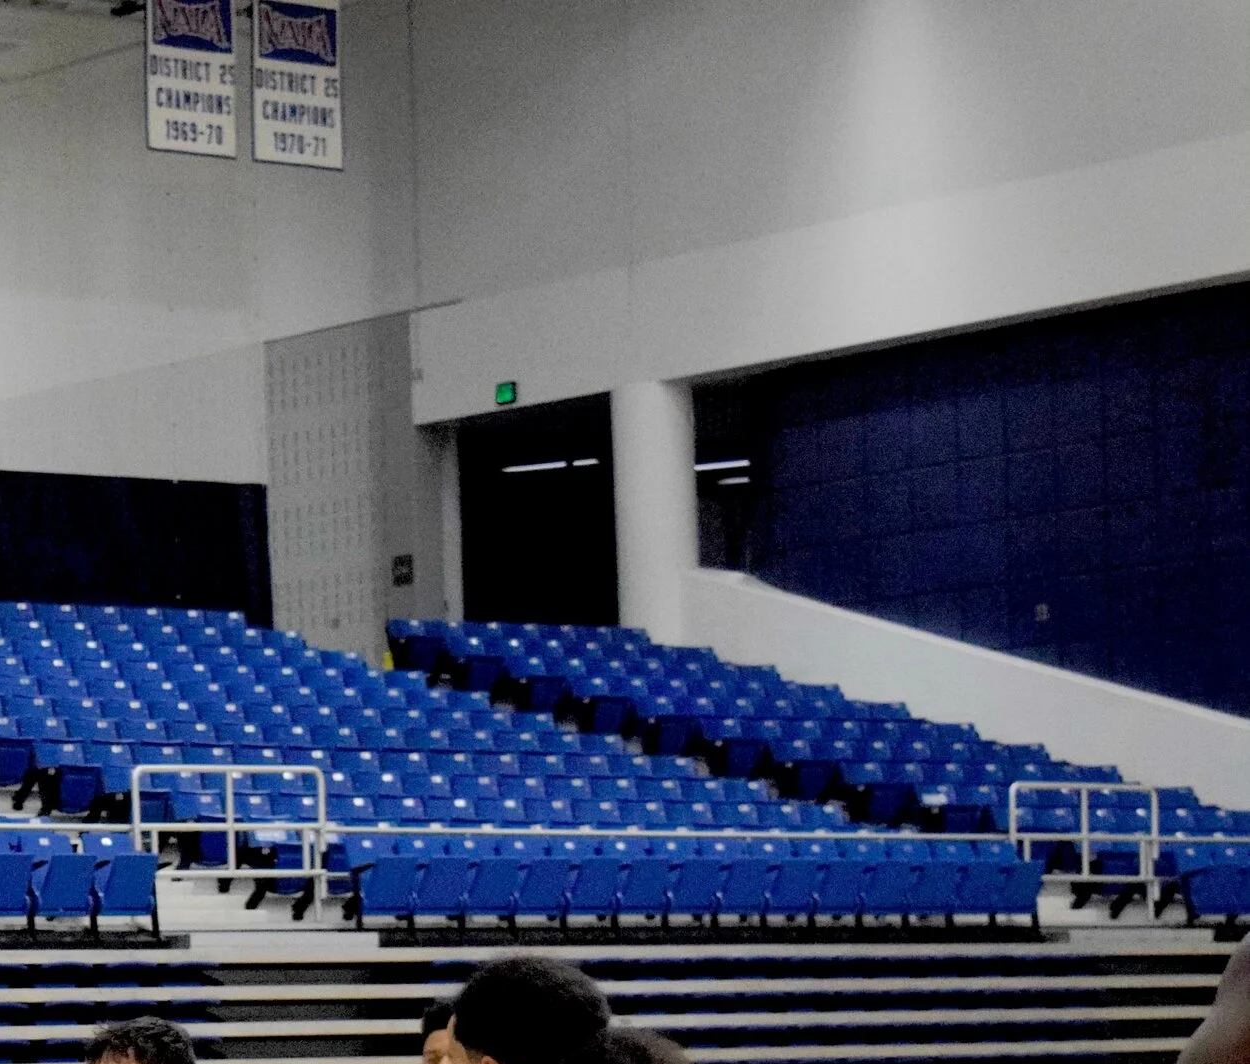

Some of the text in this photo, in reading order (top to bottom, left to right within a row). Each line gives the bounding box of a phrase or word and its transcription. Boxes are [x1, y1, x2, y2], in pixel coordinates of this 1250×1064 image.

[150, 53, 211, 83] DISTRICT
[254, 67, 339, 98] DISTRICT 25
[156, 86, 232, 116] CHAMPIONS
[262, 99, 335, 129] CHAMPIONS
[165, 119, 224, 146] 1969-70
[273, 131, 328, 157] 1970-71
